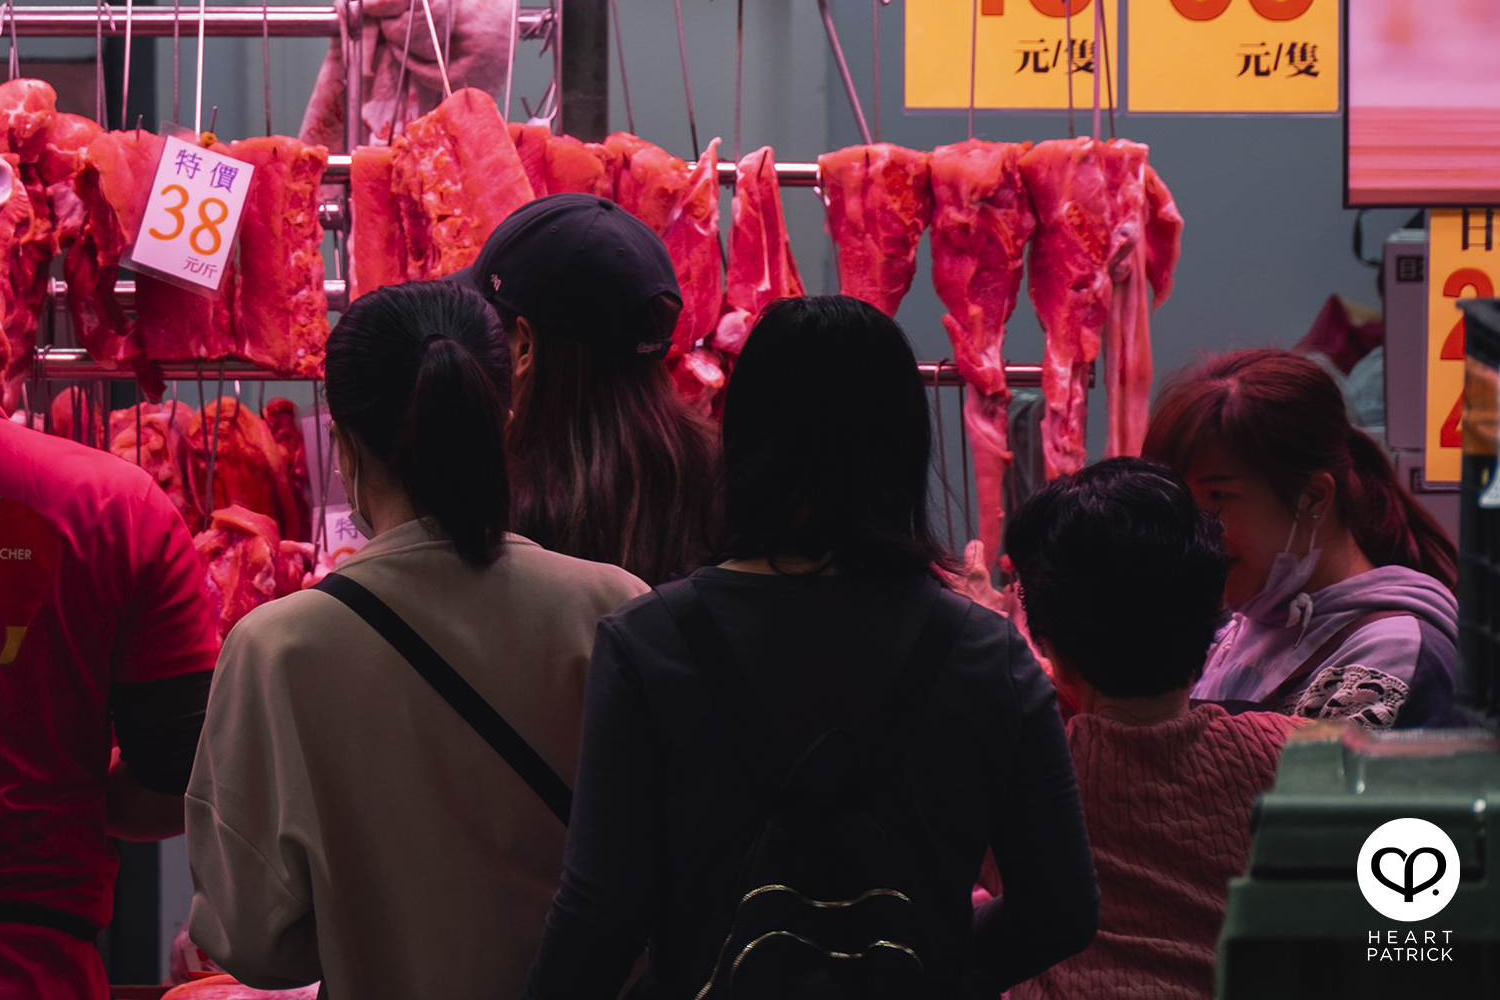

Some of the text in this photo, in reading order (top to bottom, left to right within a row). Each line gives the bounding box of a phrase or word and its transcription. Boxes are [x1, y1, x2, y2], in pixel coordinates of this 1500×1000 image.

[1235, 41, 1321, 79] 元/隻
[175, 149, 239, 194] 特價
[149, 184, 229, 256] 38
[183, 256, 218, 279] 元/斤
